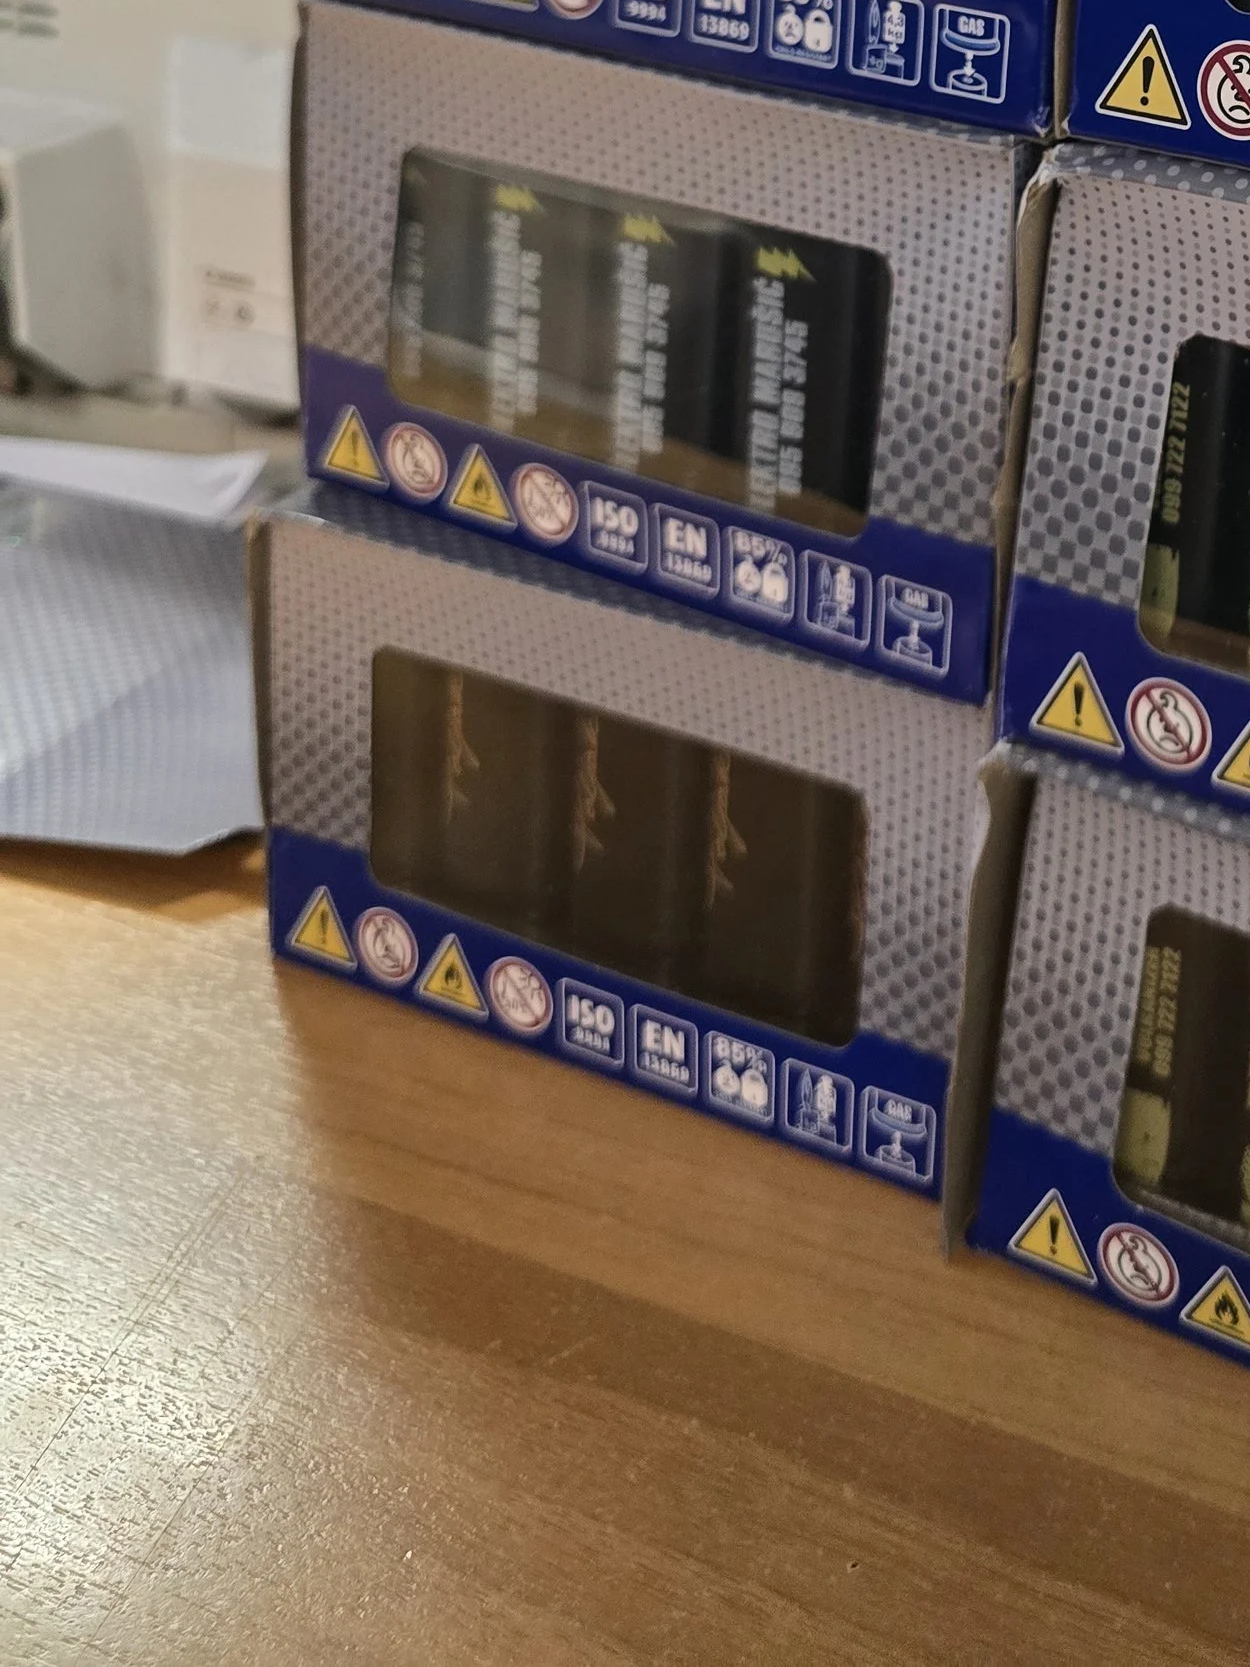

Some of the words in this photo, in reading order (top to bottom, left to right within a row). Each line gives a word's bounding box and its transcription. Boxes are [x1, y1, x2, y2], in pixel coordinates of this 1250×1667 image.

[700, 15, 750, 41] 13869
[957, 16, 986, 37] GAS
[592, 497, 638, 538] ISO
[664, 517, 707, 560] EN
[567, 994, 616, 1035] ISO
[643, 1019, 686, 1063] EN
